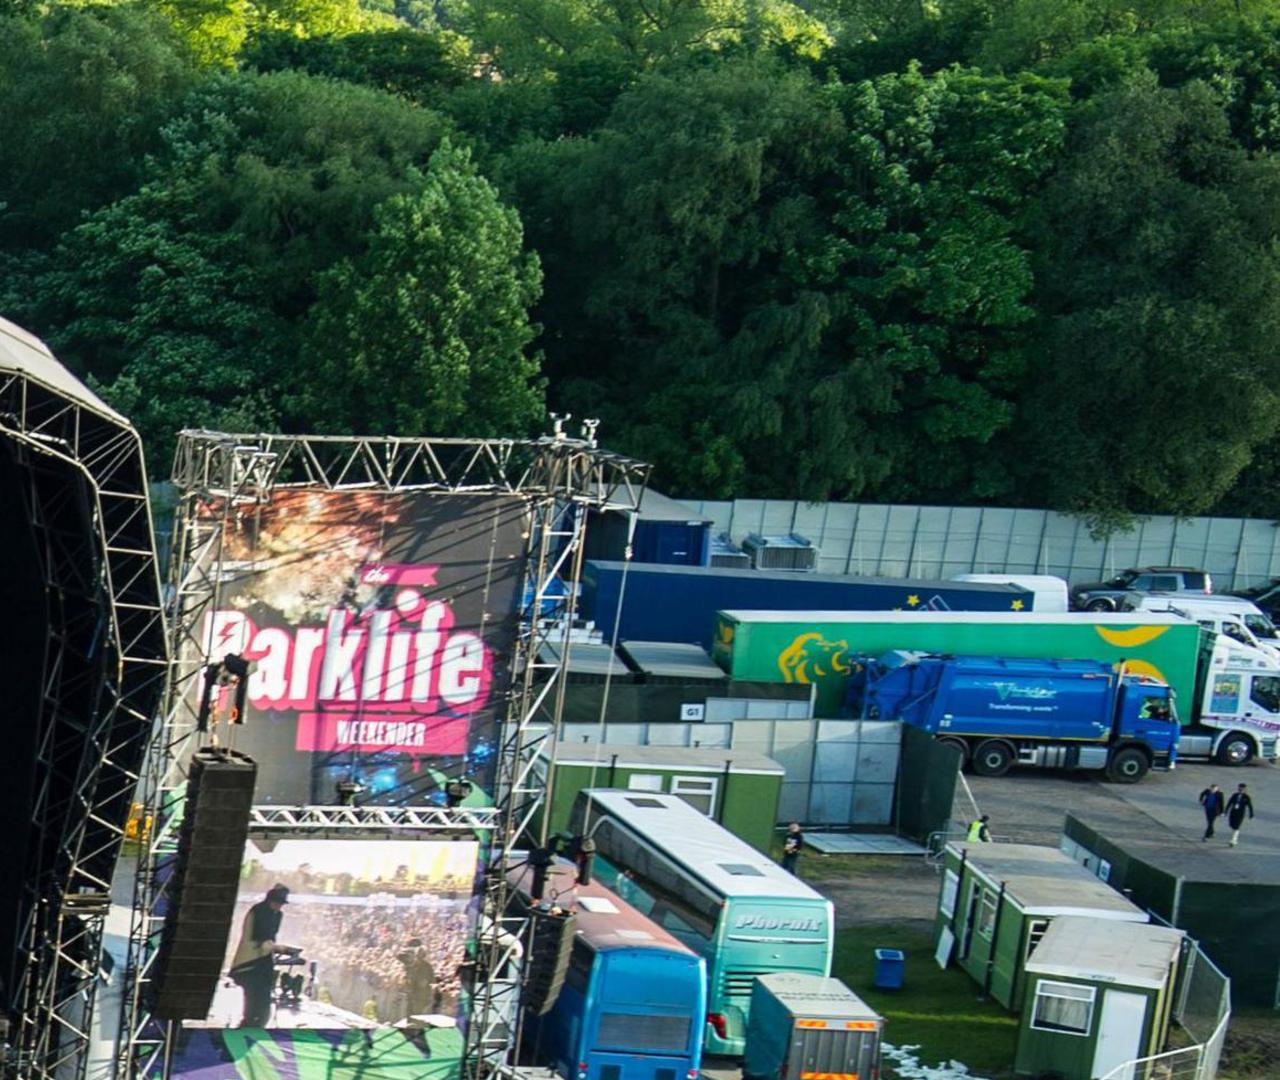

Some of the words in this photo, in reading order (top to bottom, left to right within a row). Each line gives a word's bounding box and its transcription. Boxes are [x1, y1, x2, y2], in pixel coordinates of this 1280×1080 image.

[363, 566, 391, 583] the
[200, 589, 486, 704] Parklife
[336, 719, 425, 747] WEEKENDER
[735, 914, 822, 932] Phoenix
